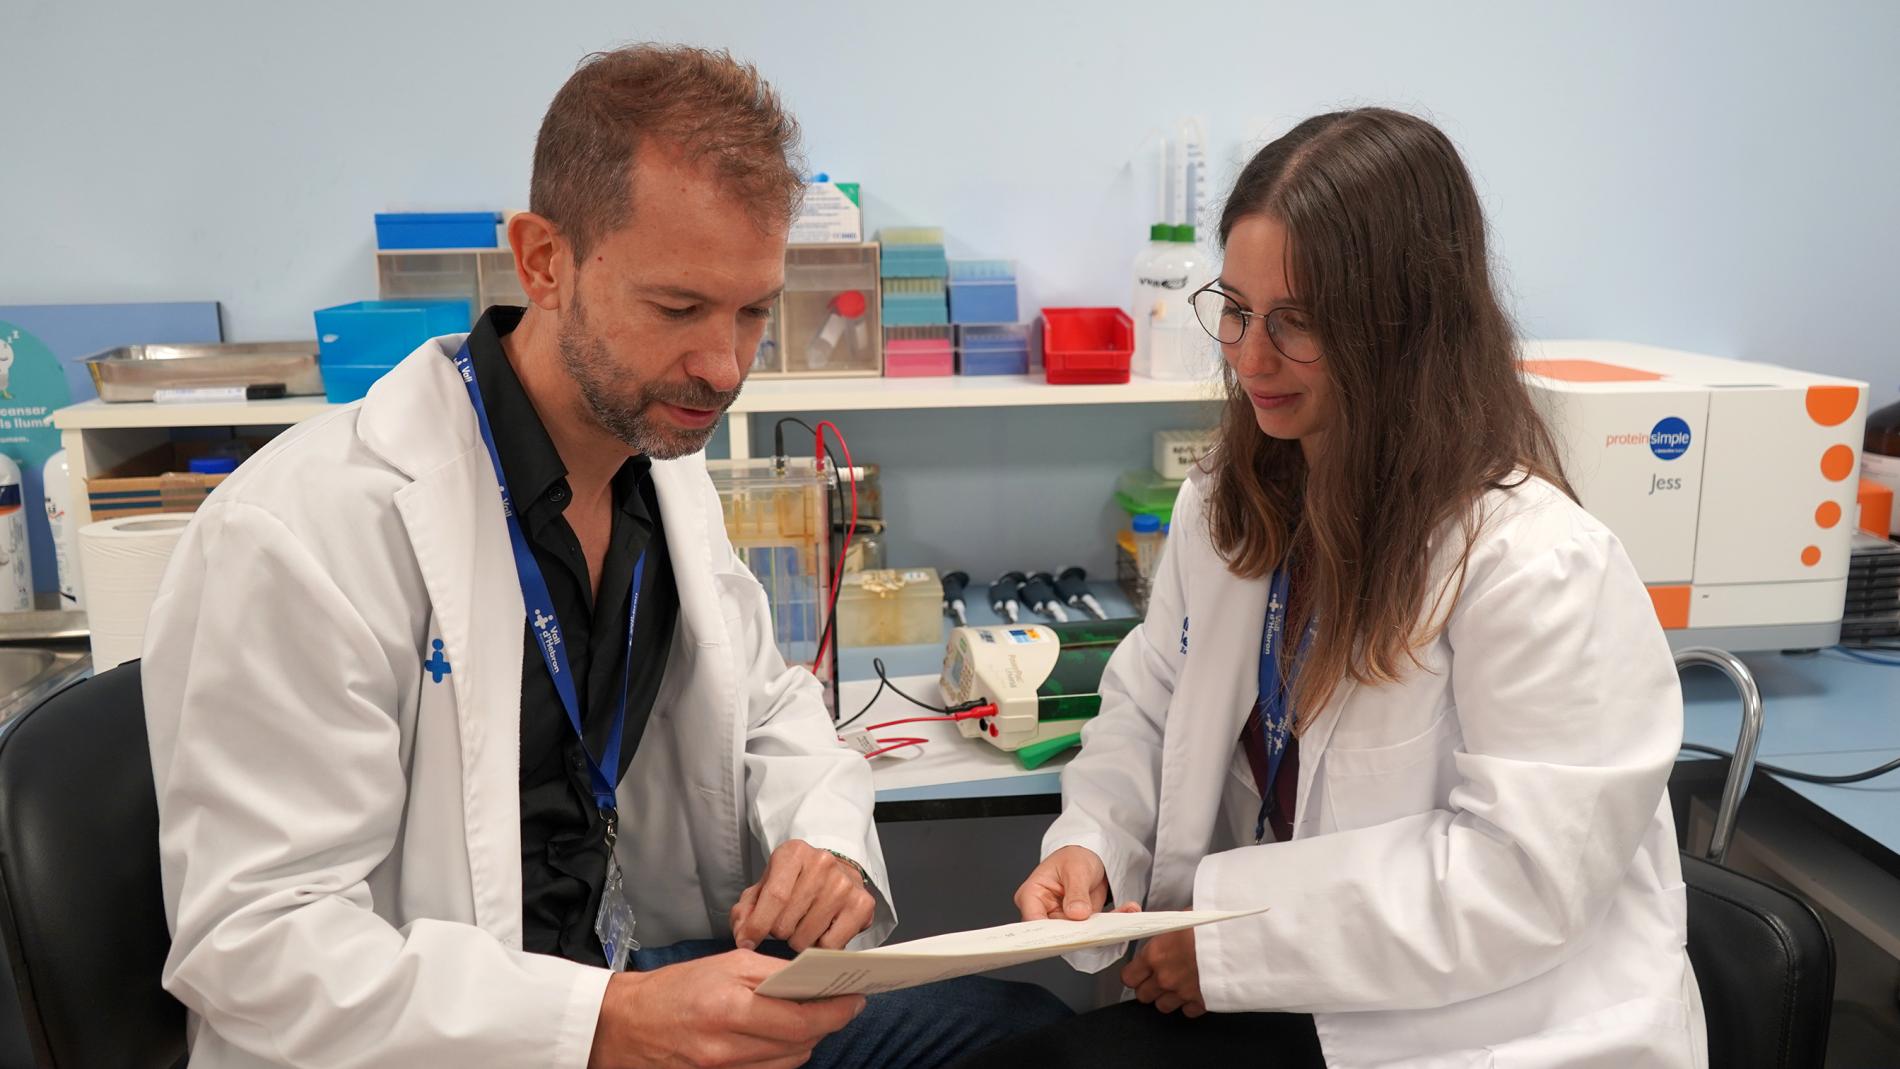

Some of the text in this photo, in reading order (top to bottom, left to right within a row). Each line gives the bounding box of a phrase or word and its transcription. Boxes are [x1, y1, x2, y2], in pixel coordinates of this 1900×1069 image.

[461, 365, 473, 383] Vall
[1648, 473, 1682, 496] Jess
[1265, 613, 1276, 655] d'Hebron
[1273, 615, 1282, 632] Vall
[550, 625, 561, 645] Vall
[542, 630, 560, 673] d'Hebron
